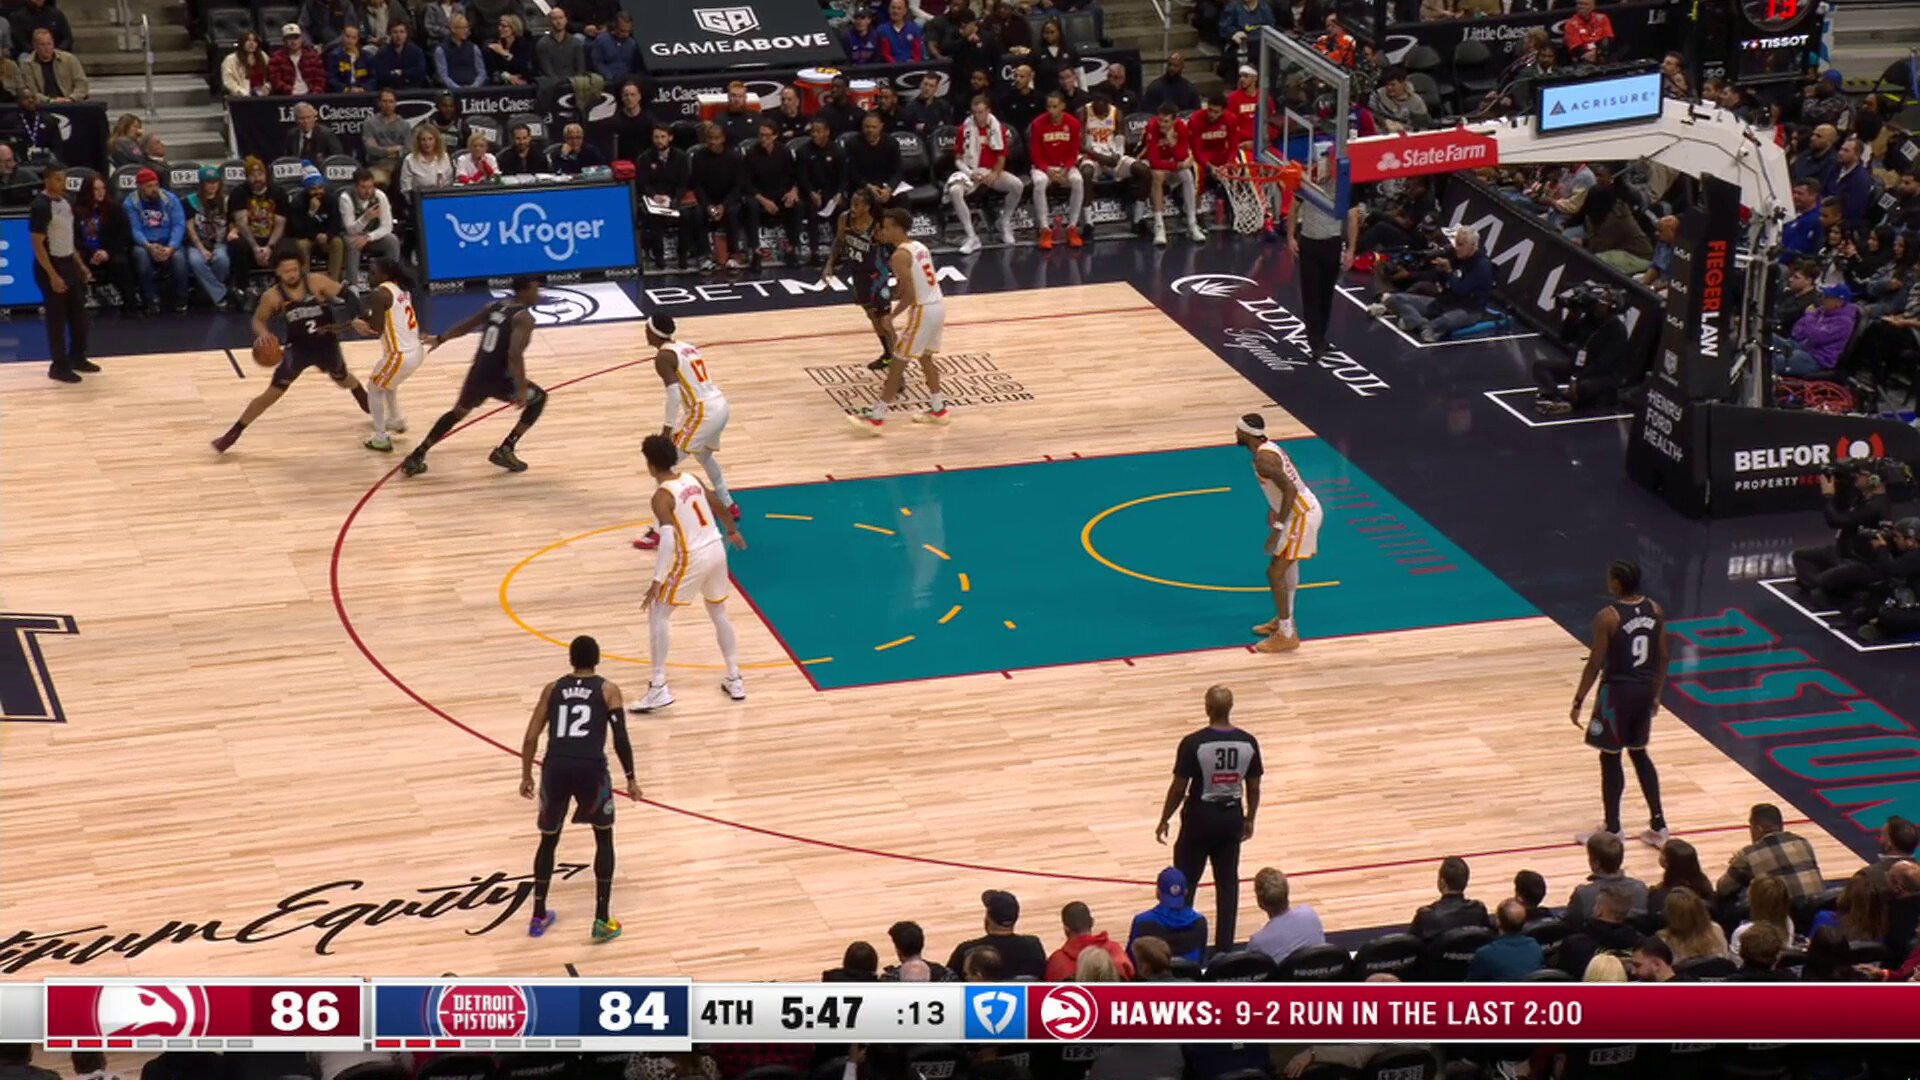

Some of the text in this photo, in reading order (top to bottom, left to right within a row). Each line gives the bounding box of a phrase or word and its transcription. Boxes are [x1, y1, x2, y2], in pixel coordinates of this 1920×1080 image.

[651, 33, 830, 57] GAMEABOVE
[1759, 35, 1809, 49] TISSOT
[319, 104, 374, 121] Caesars
[461, 98, 499, 115] Little
[1571, 91, 1649, 111] ACRISURE
[499, 202, 605, 262] Kroger
[922, 263, 937, 287] 5
[305, 319, 317, 335] 2
[482, 325, 500, 353] 0
[690, 359, 709, 383] 17
[980, 391, 1035, 405] CLUB
[1735, 444, 1831, 473] BELFOR
[692, 500, 708, 528] 1
[1631, 635, 1649, 668] 9
[556, 704, 592, 738] 12
[1663, 607, 1920, 862] PISTON
[1215, 747, 1238, 771] 30
[234, 867, 562, 957] Equity
